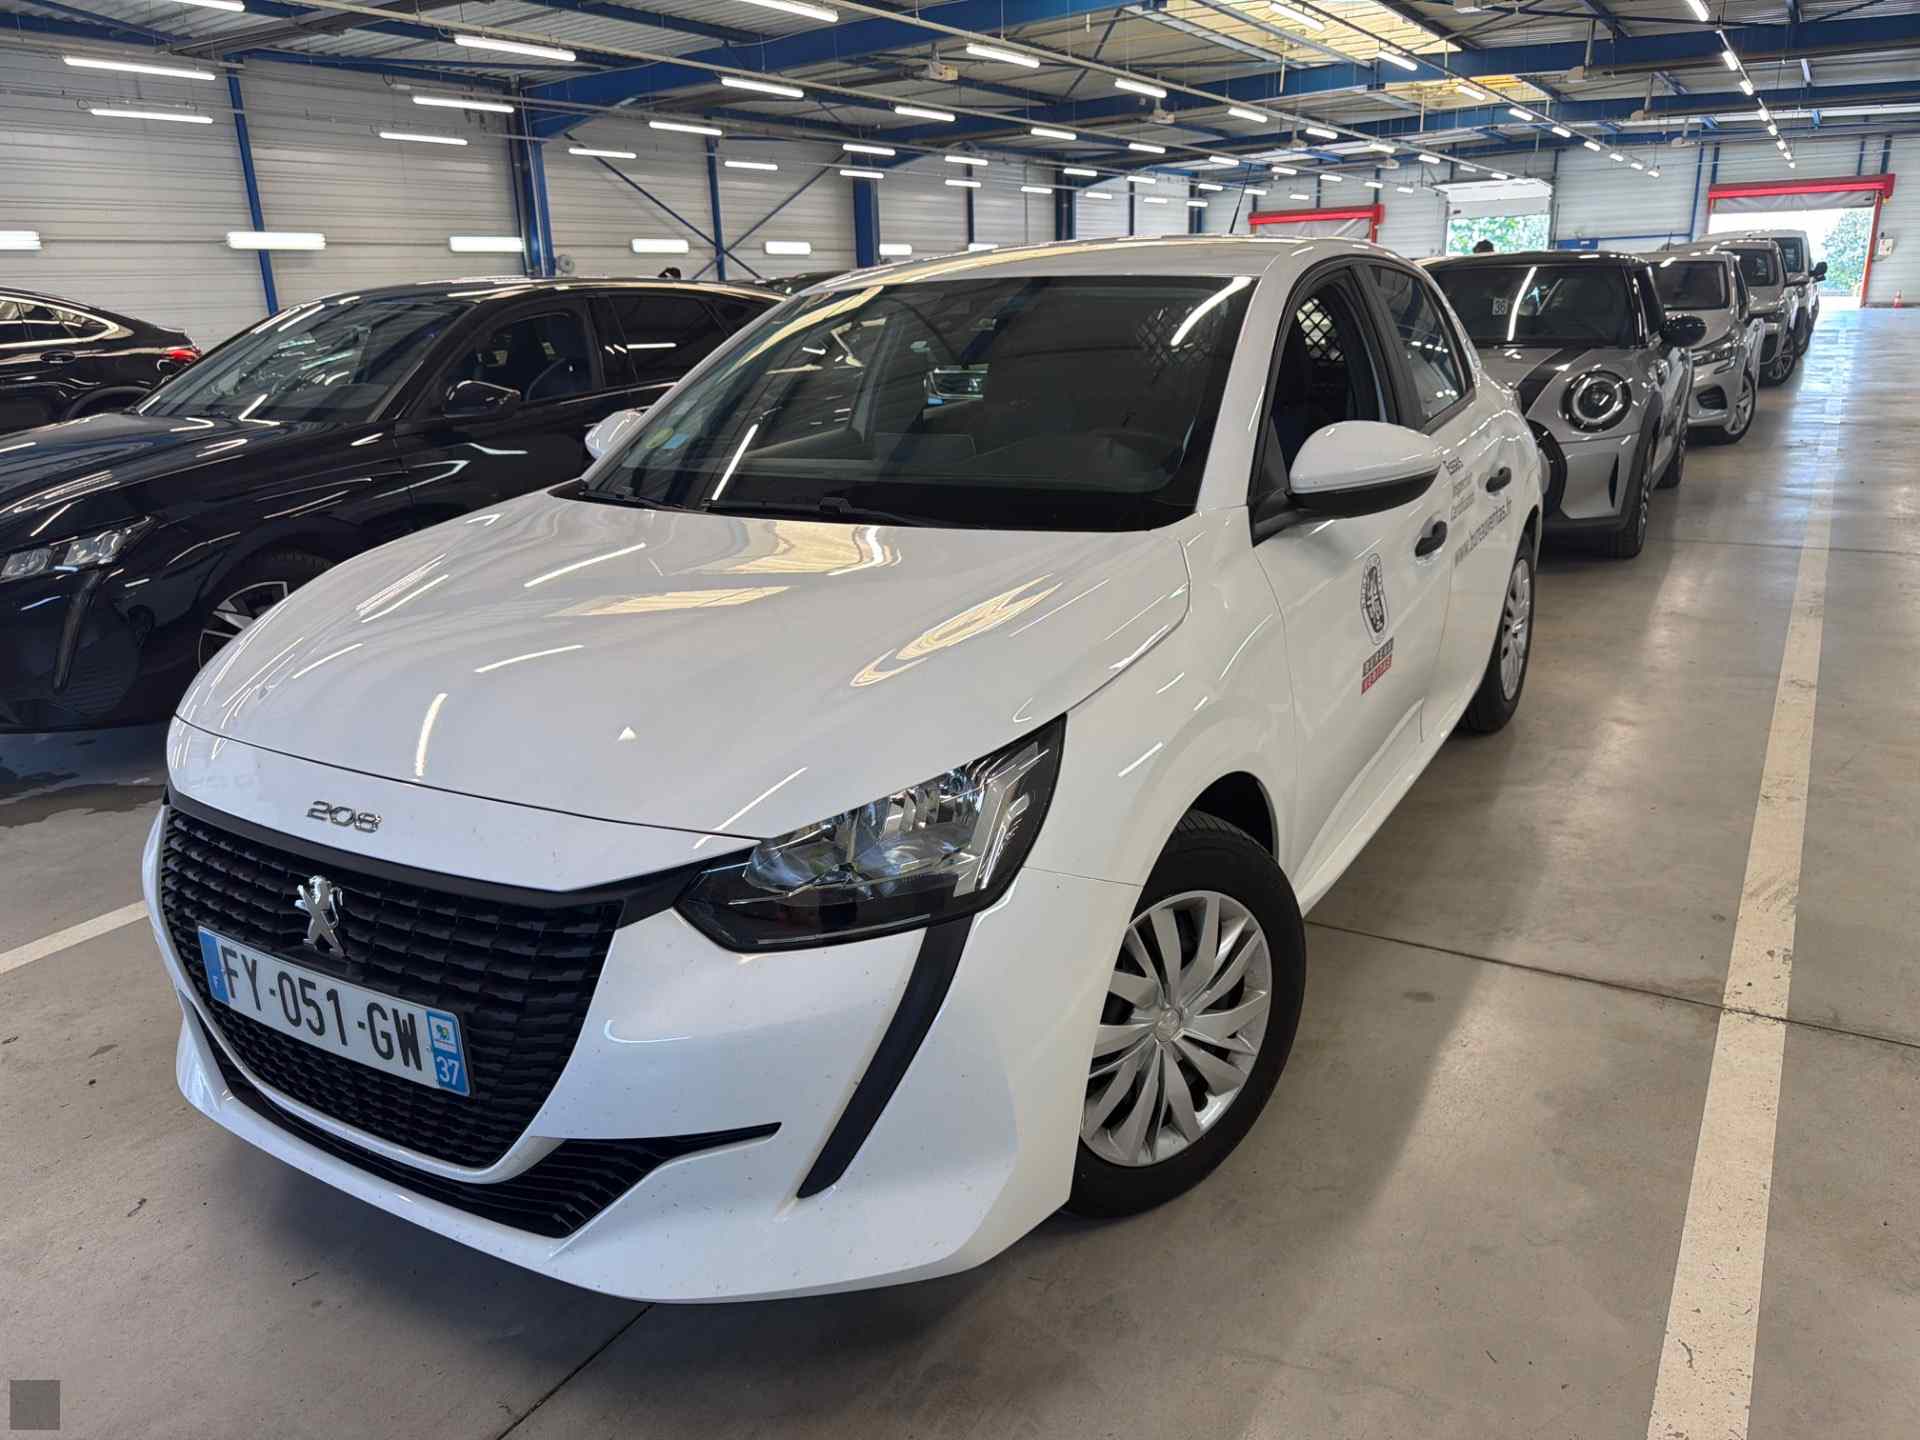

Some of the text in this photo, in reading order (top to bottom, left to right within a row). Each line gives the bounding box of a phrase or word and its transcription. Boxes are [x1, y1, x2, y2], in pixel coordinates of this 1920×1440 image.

[306, 800, 382, 833] 208
[220, 945, 423, 1071] FY-051-GW
[436, 1055, 461, 1086] 37
